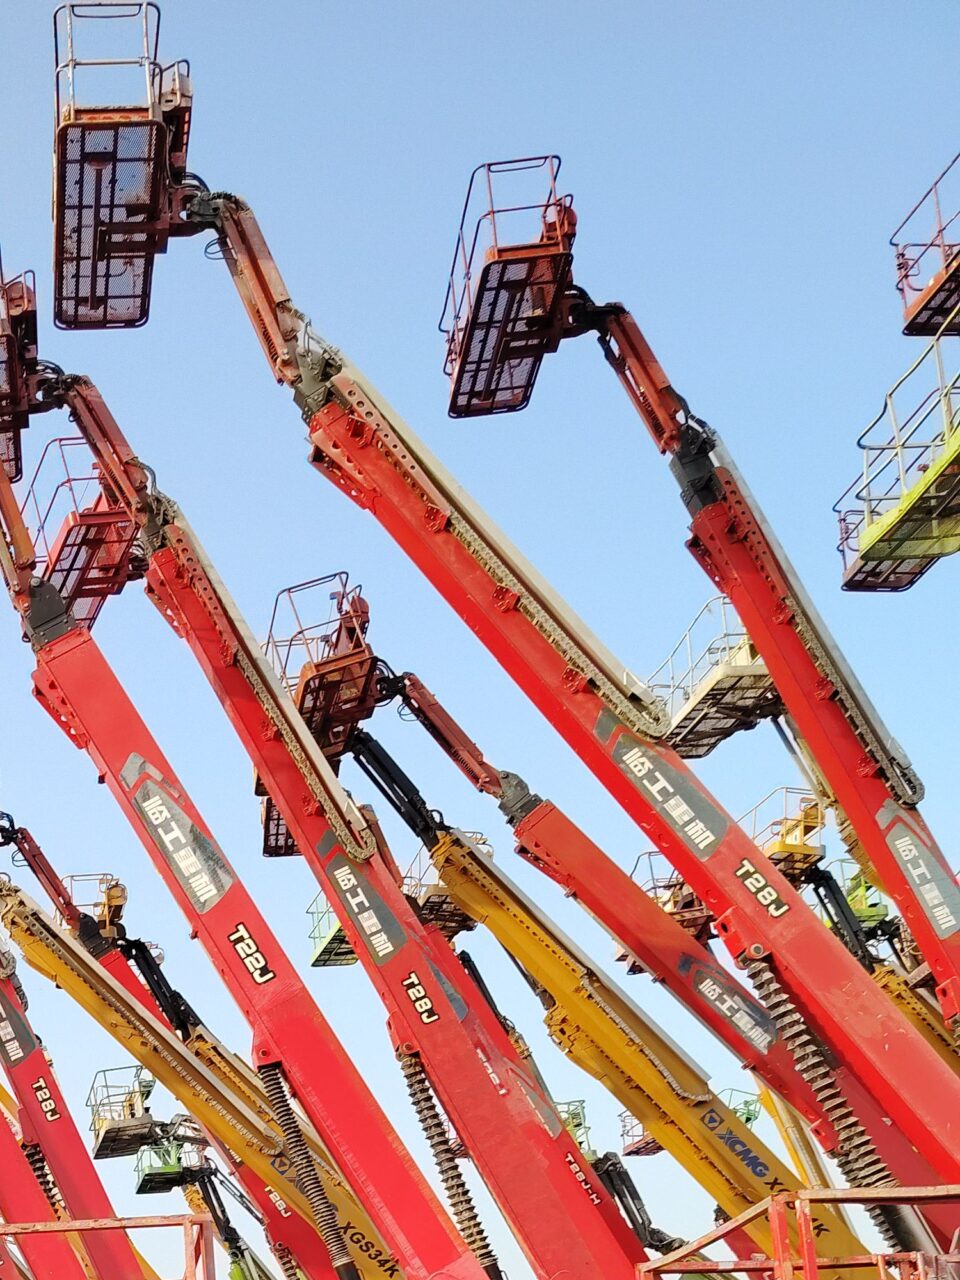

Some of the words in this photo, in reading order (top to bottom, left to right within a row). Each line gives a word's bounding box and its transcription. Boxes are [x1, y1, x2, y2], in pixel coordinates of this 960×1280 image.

[622, 747, 716, 850] 临工重机
[734, 858, 790, 918] T28J
[142, 795, 218, 902] 临工重机
[228, 922, 277, 985] T22J
[333, 865, 394, 957] 临工重机
[401, 972, 439, 1024] T28J
[31, 1076, 61, 1122] T28J
[714, 1127, 770, 1178] XCMG
[339, 1221, 399, 1279] XGS34K
